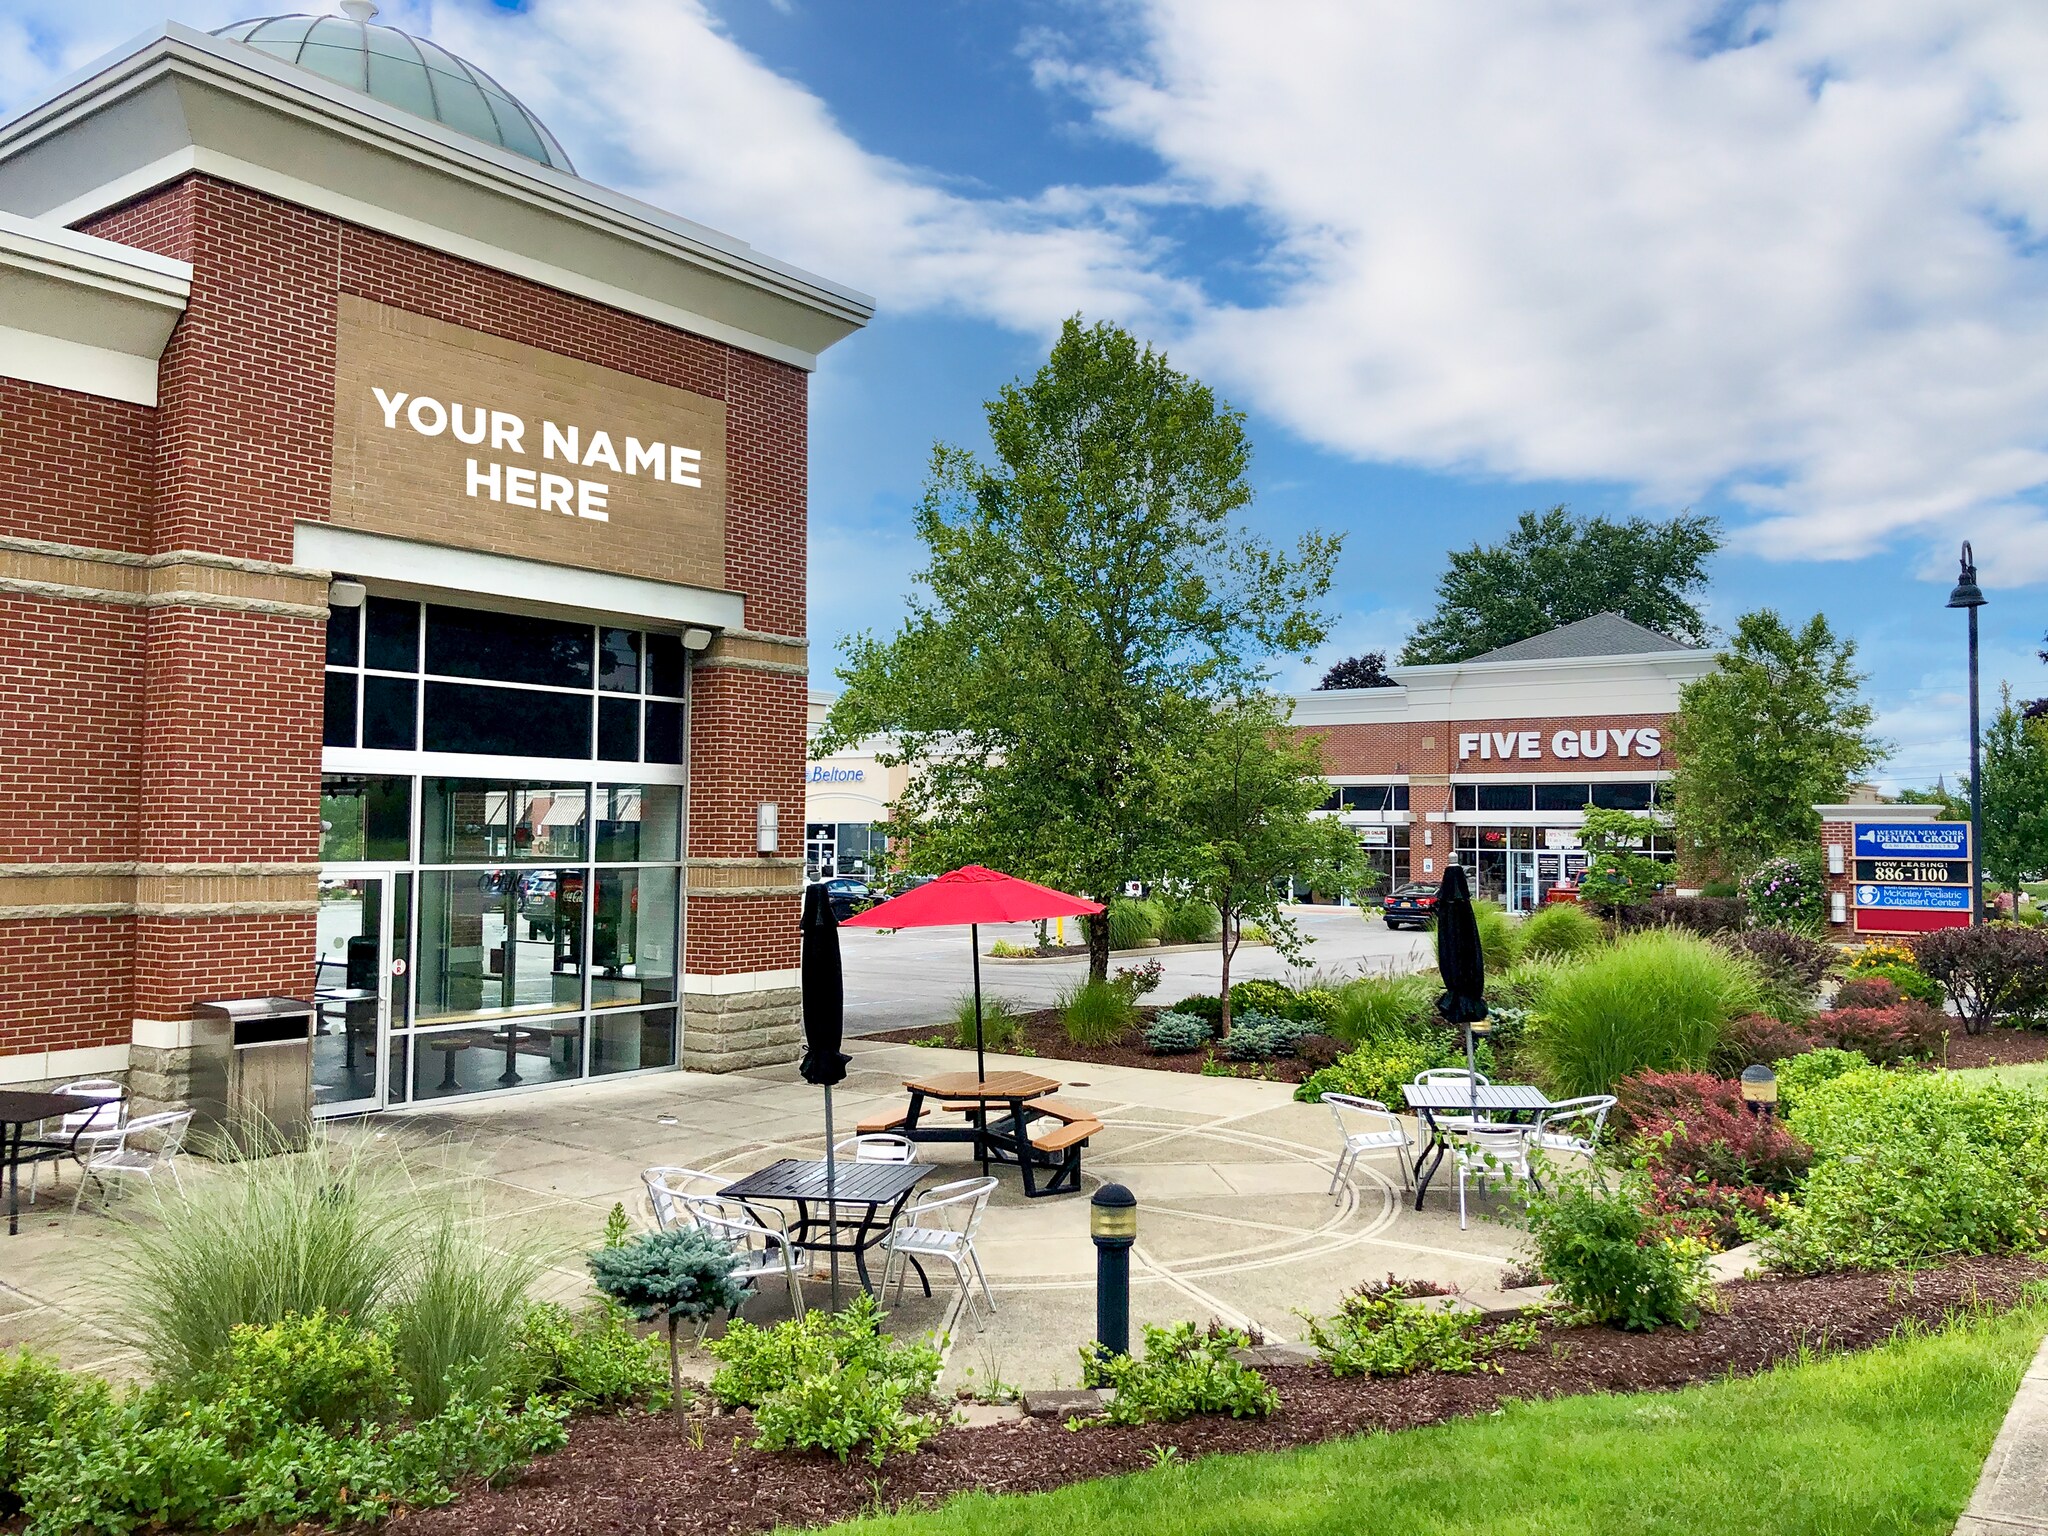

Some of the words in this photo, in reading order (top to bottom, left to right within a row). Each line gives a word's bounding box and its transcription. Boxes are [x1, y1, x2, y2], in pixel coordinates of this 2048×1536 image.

[371, 386, 526, 454] YOUR
[543, 420, 702, 489] NAME
[466, 458, 609, 523] HERE
[1459, 731, 1542, 760] FIVE
[1552, 728, 1662, 758] GUYS
[812, 766, 864, 782] Beltone
[1876, 835, 1920, 843] DENTAL
[1922, 835, 1965, 843] GROUP
[1875, 867, 1948, 881] 886-1100
[1883, 889, 1922, 899] McKinley
[1924, 890, 1962, 899] Pediatric
[1884, 897, 1929, 906] Outpatient
[1930, 898, 1961, 907] Center
